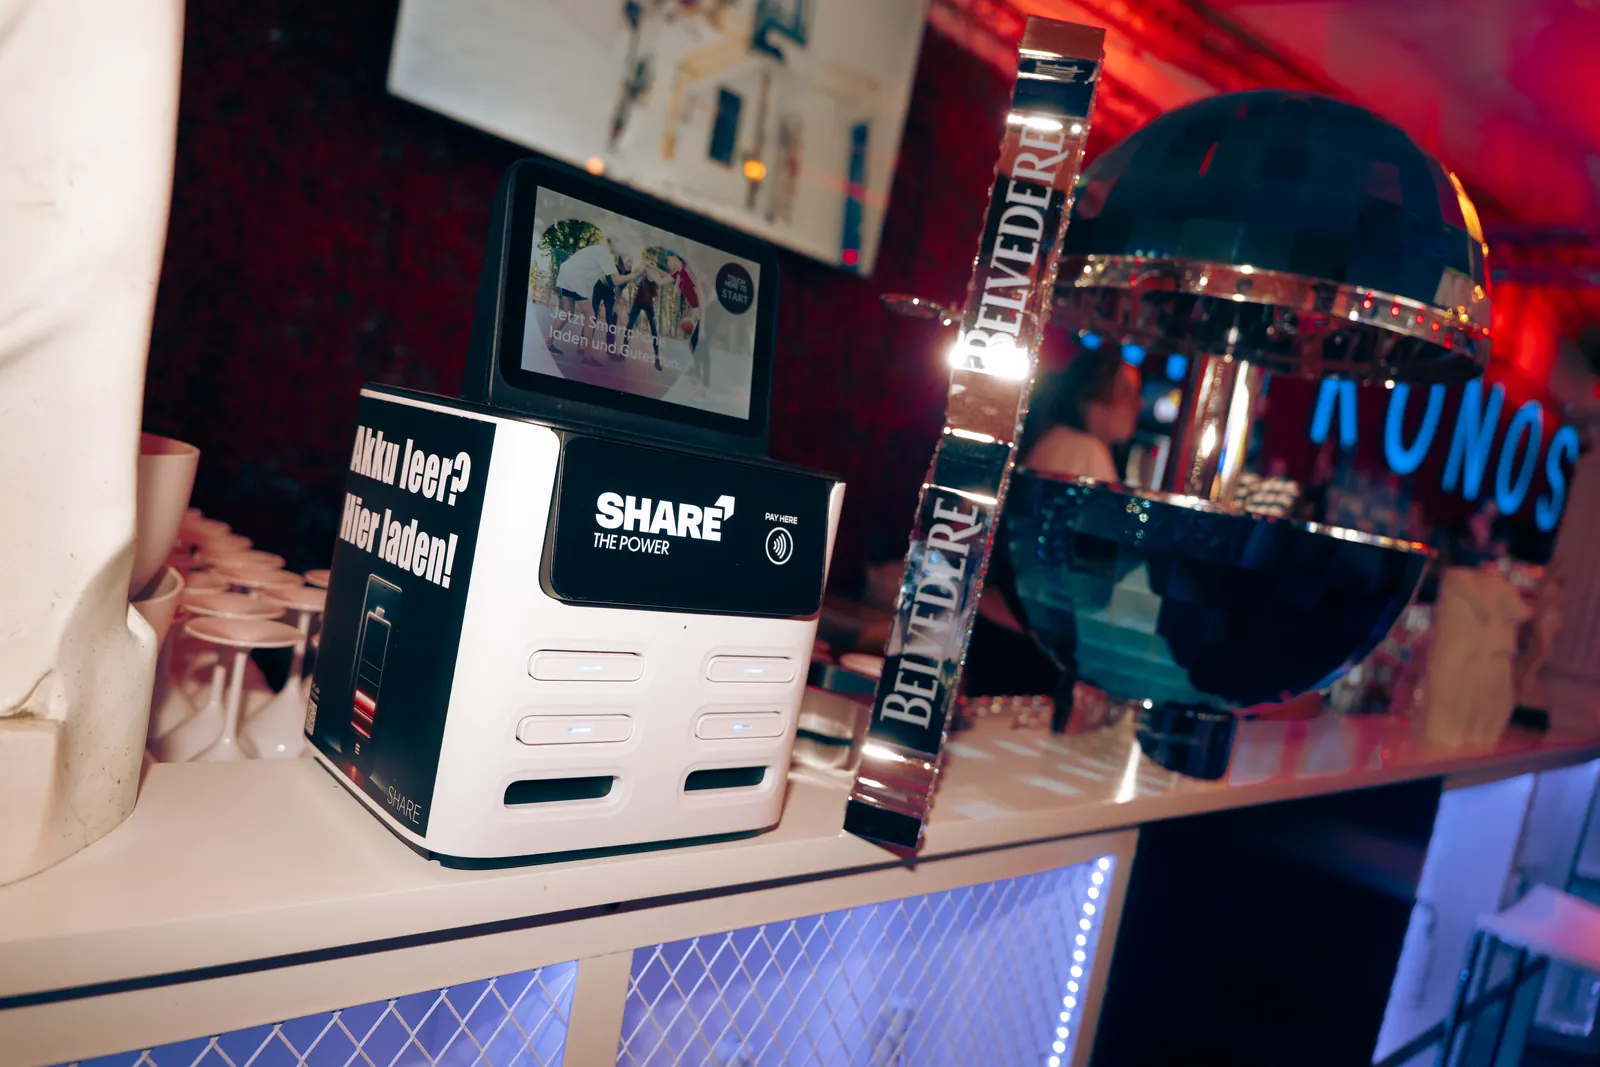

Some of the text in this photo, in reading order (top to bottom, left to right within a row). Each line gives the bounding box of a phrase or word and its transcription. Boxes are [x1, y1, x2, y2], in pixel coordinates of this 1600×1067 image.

[955, 127, 1070, 362] BELVEDERE
[721, 287, 749, 304] START
[549, 325, 588, 347] laden
[591, 338, 617, 354] und
[620, 344, 656, 364] Gutes
[550, 306, 666, 347] Jetzt Smartphone
[349, 424, 472, 507] Akku leer?
[595, 492, 723, 542] SHARE
[765, 512, 798, 525] PAY HERE
[340, 492, 459, 590] Hier laden!
[593, 532, 670, 556] THE POWER
[880, 497, 983, 730] BELVEDERE
[386, 785, 422, 825] SHARE
